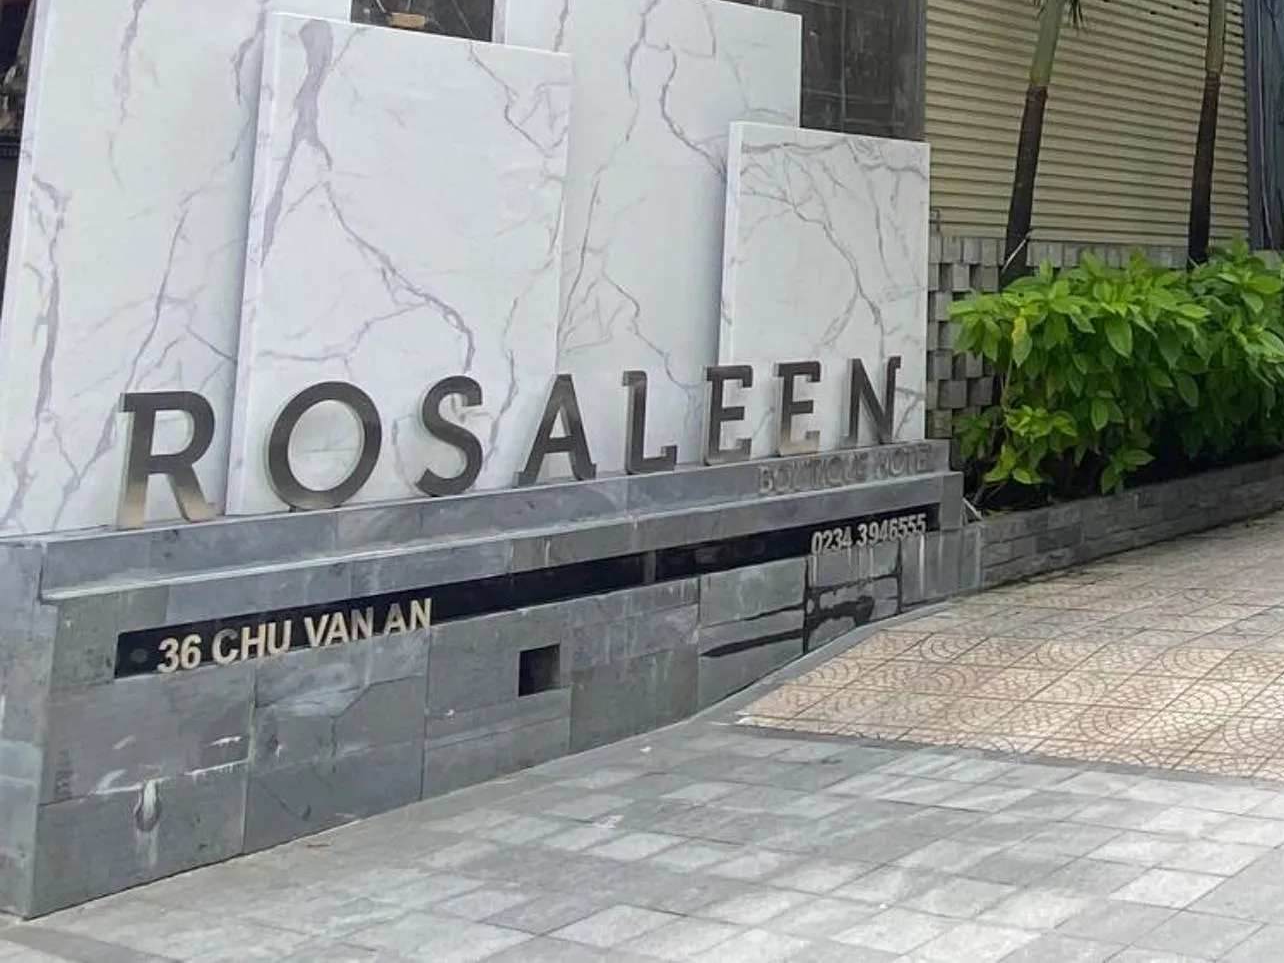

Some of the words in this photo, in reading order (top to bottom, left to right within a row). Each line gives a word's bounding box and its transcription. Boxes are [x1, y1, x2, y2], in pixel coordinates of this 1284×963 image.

[116, 356, 903, 529] ROSALEEN
[157, 634, 201, 673] 36
[211, 616, 292, 665] CHU
[303, 606, 374, 648] VAN
[383, 597, 433, 635] AN
